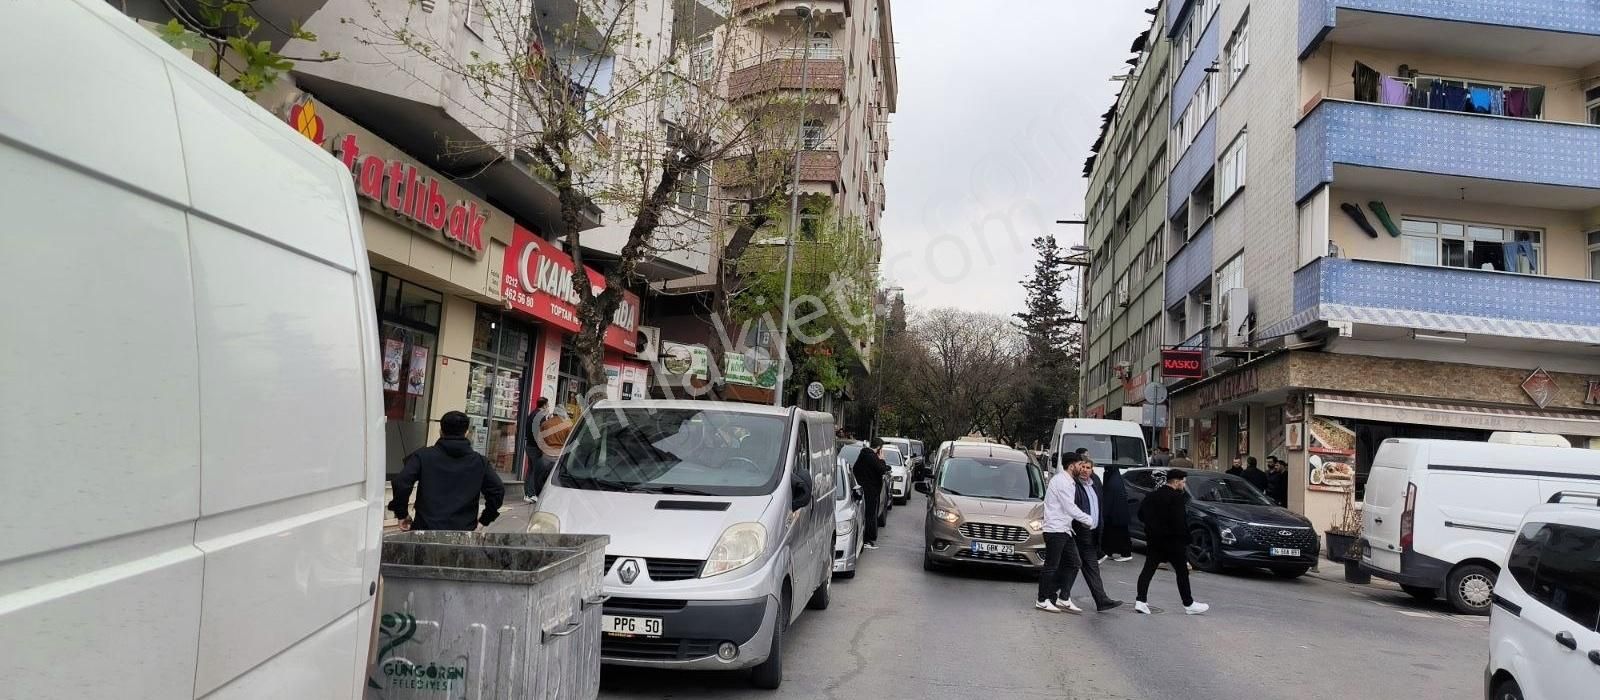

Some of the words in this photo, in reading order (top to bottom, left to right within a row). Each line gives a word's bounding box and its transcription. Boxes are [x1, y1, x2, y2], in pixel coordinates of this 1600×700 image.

[341, 133, 487, 253] tatlıbak
[505, 274, 518, 288] 0212
[504, 287, 517, 301] 462
[517, 292, 526, 305] 56
[526, 296, 534, 308] 80
[550, 302, 573, 323] TOPTAN
[1164, 359, 1199, 369] KASKO
[614, 617, 635, 631] PPG
[645, 619, 660, 633] 50
[383, 660, 464, 679] GÜNGÖREN
